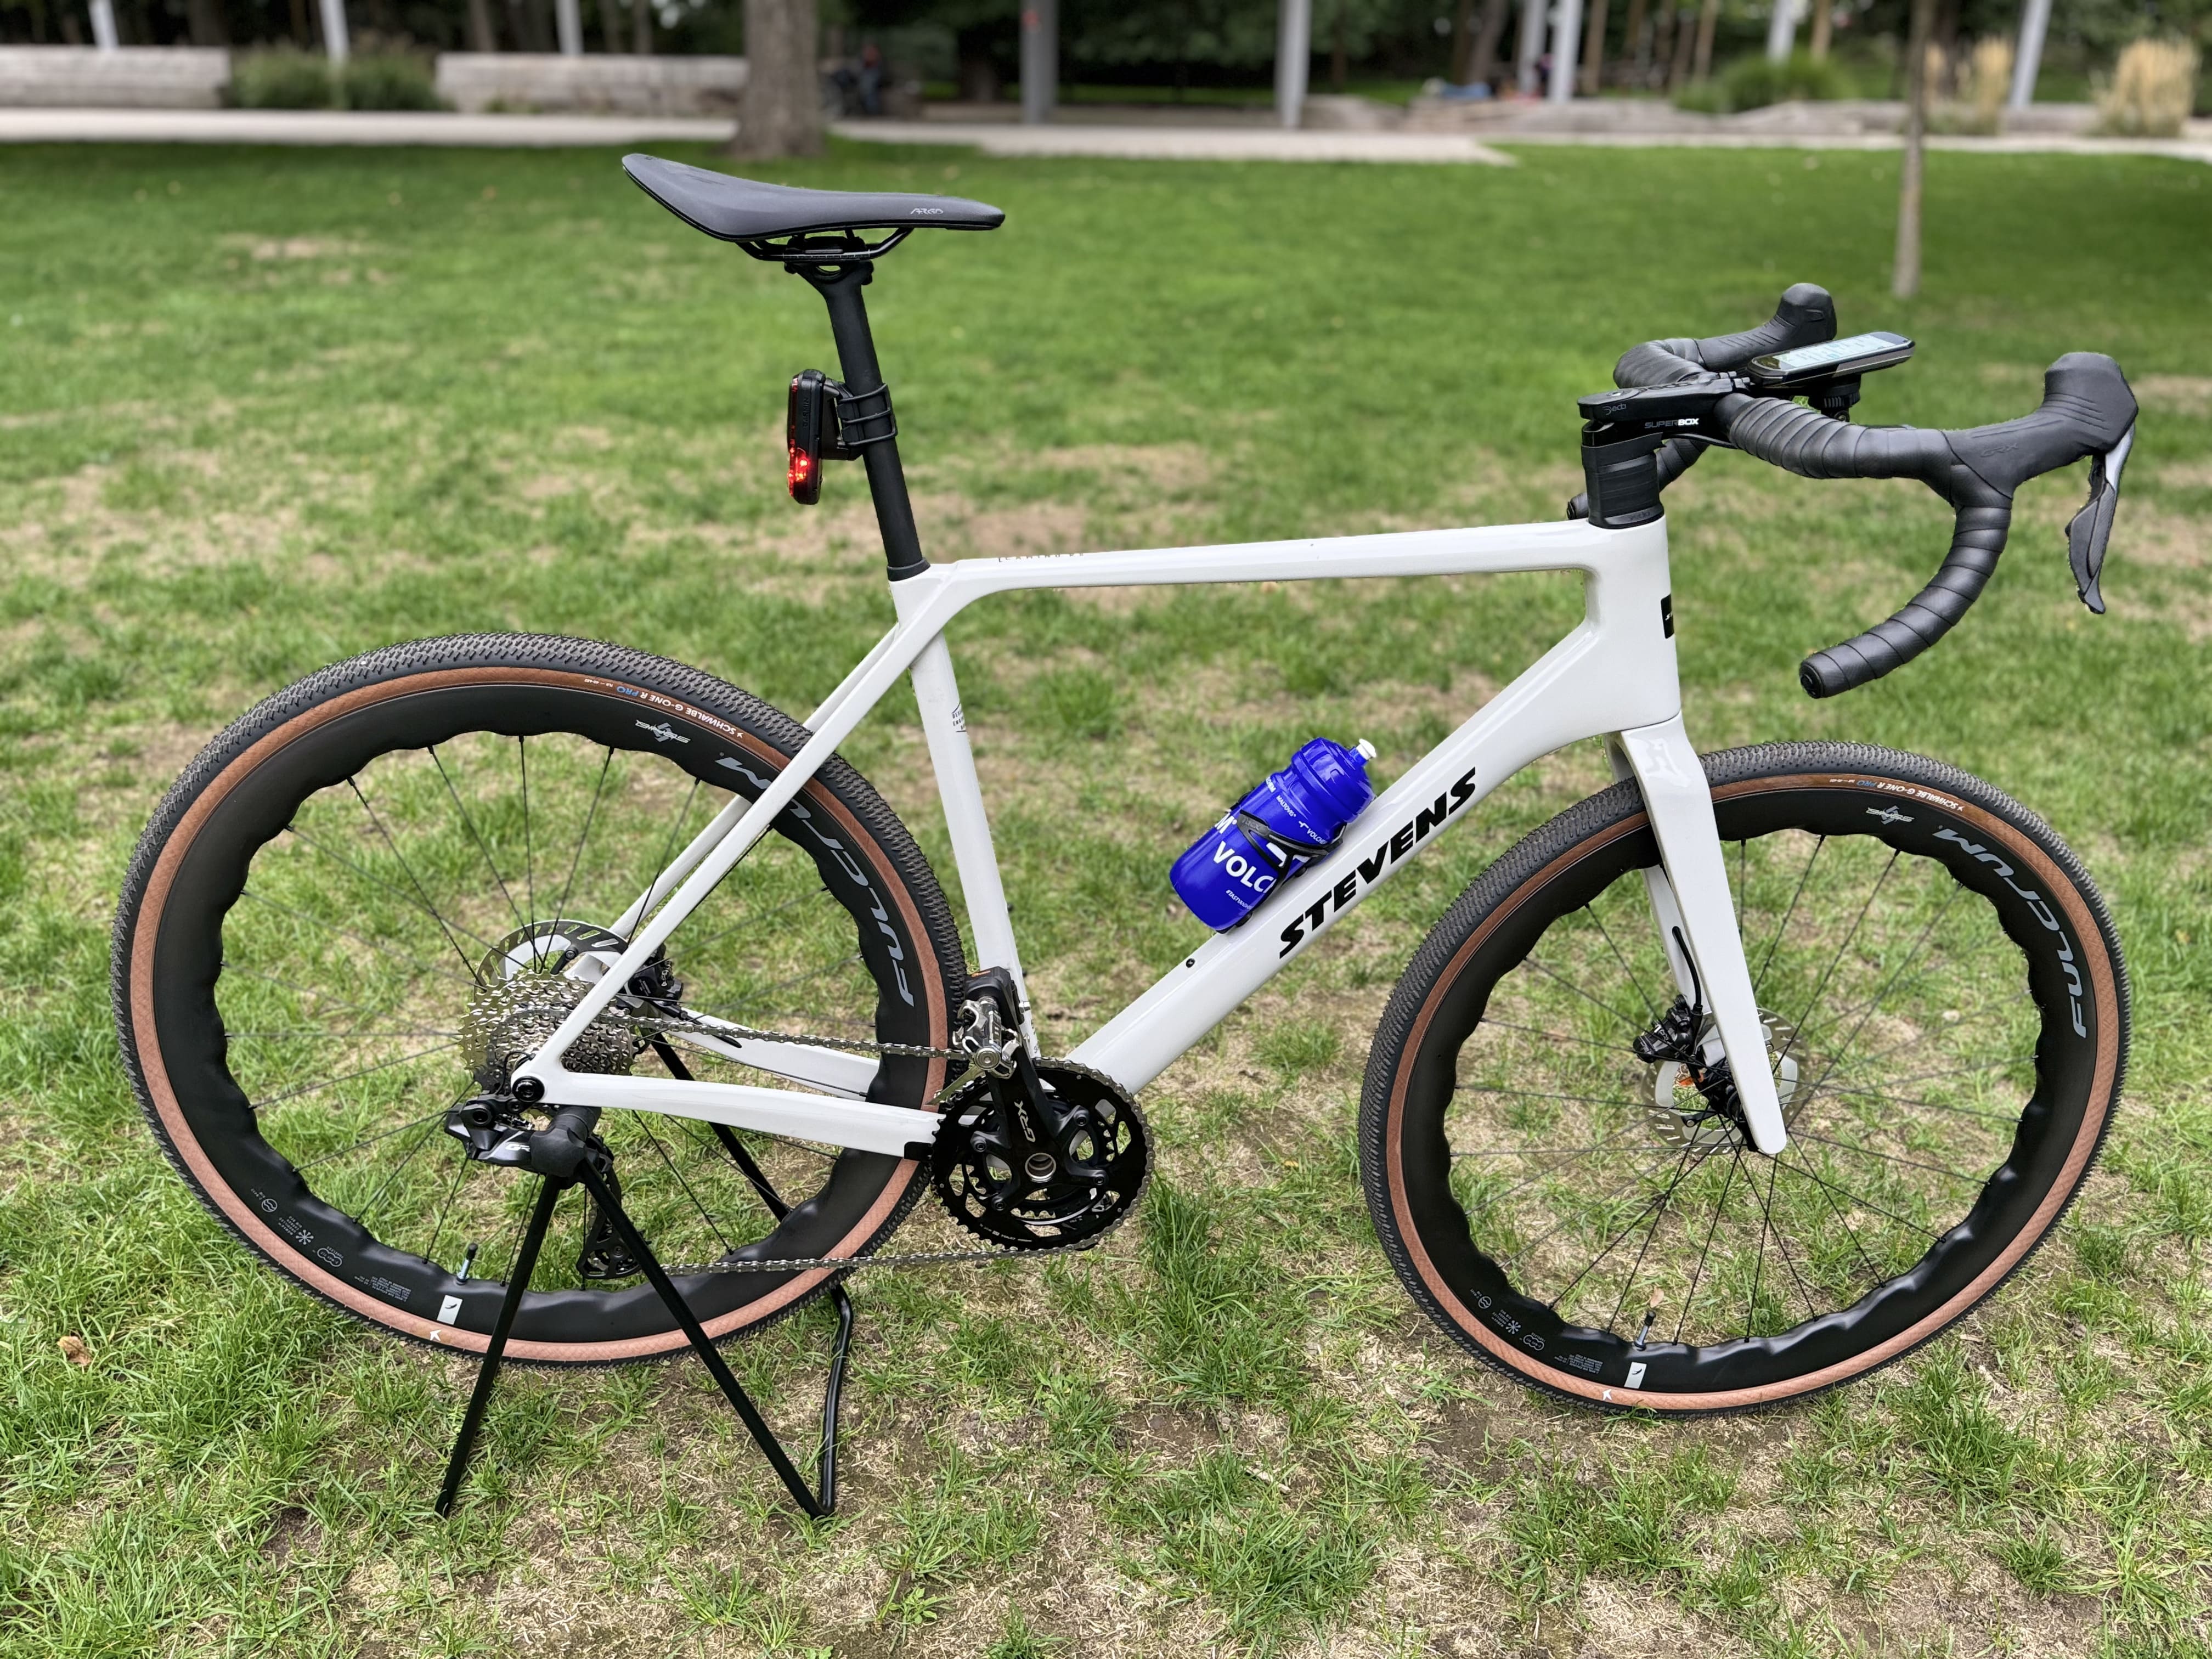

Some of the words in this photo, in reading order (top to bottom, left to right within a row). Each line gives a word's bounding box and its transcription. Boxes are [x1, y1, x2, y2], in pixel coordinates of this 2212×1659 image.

[617, 685, 639, 697] PRO
[640, 691, 648, 699] R
[650, 695, 684, 712] G-ONE
[685, 707, 737, 735] SCHWALBE
[1885, 783, 1915, 795] G-ONE
[1915, 790, 1959, 809] SCHWALBE
[1213, 840, 1277, 894] VOLC
[1279, 766, 1476, 960] STEVENS
[1932, 828, 2086, 1038] FULCRUM
[1014, 1100, 1036, 1143] GRX
[505, 1143, 531, 1152] GR
